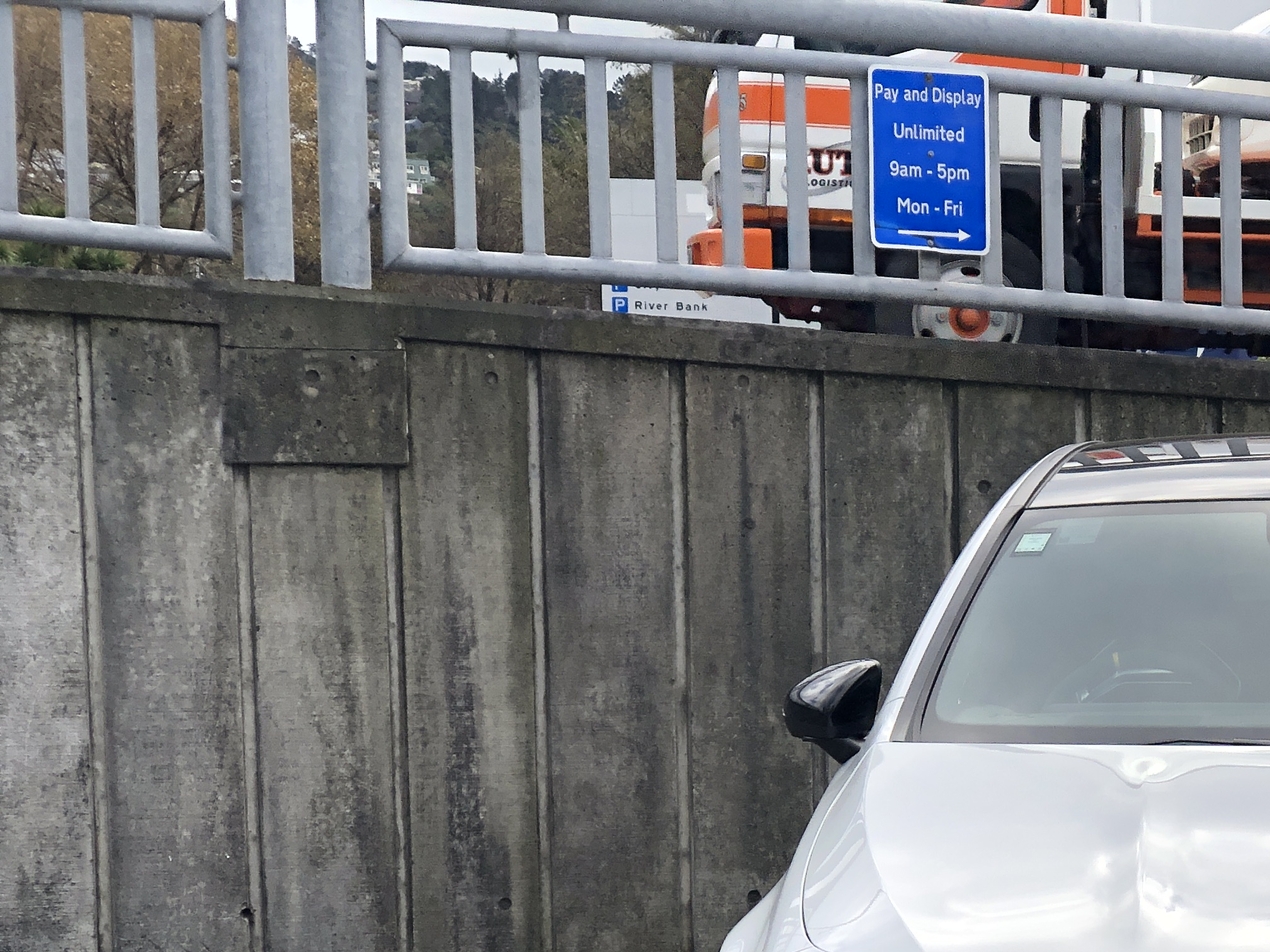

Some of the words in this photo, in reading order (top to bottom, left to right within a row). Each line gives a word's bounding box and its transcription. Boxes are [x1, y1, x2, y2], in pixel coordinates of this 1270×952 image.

[874, 83, 899, 103] Pay
[903, 87, 928, 103] and
[932, 87, 982, 109] Display
[893, 122, 965, 143] Unlimited
[889, 160, 922, 178] 9am
[937, 163, 970, 183] 5pm
[897, 197, 930, 215] Mon
[944, 200, 963, 217] Fri
[634, 300, 668, 311] River
[676, 301, 708, 312] Bank
